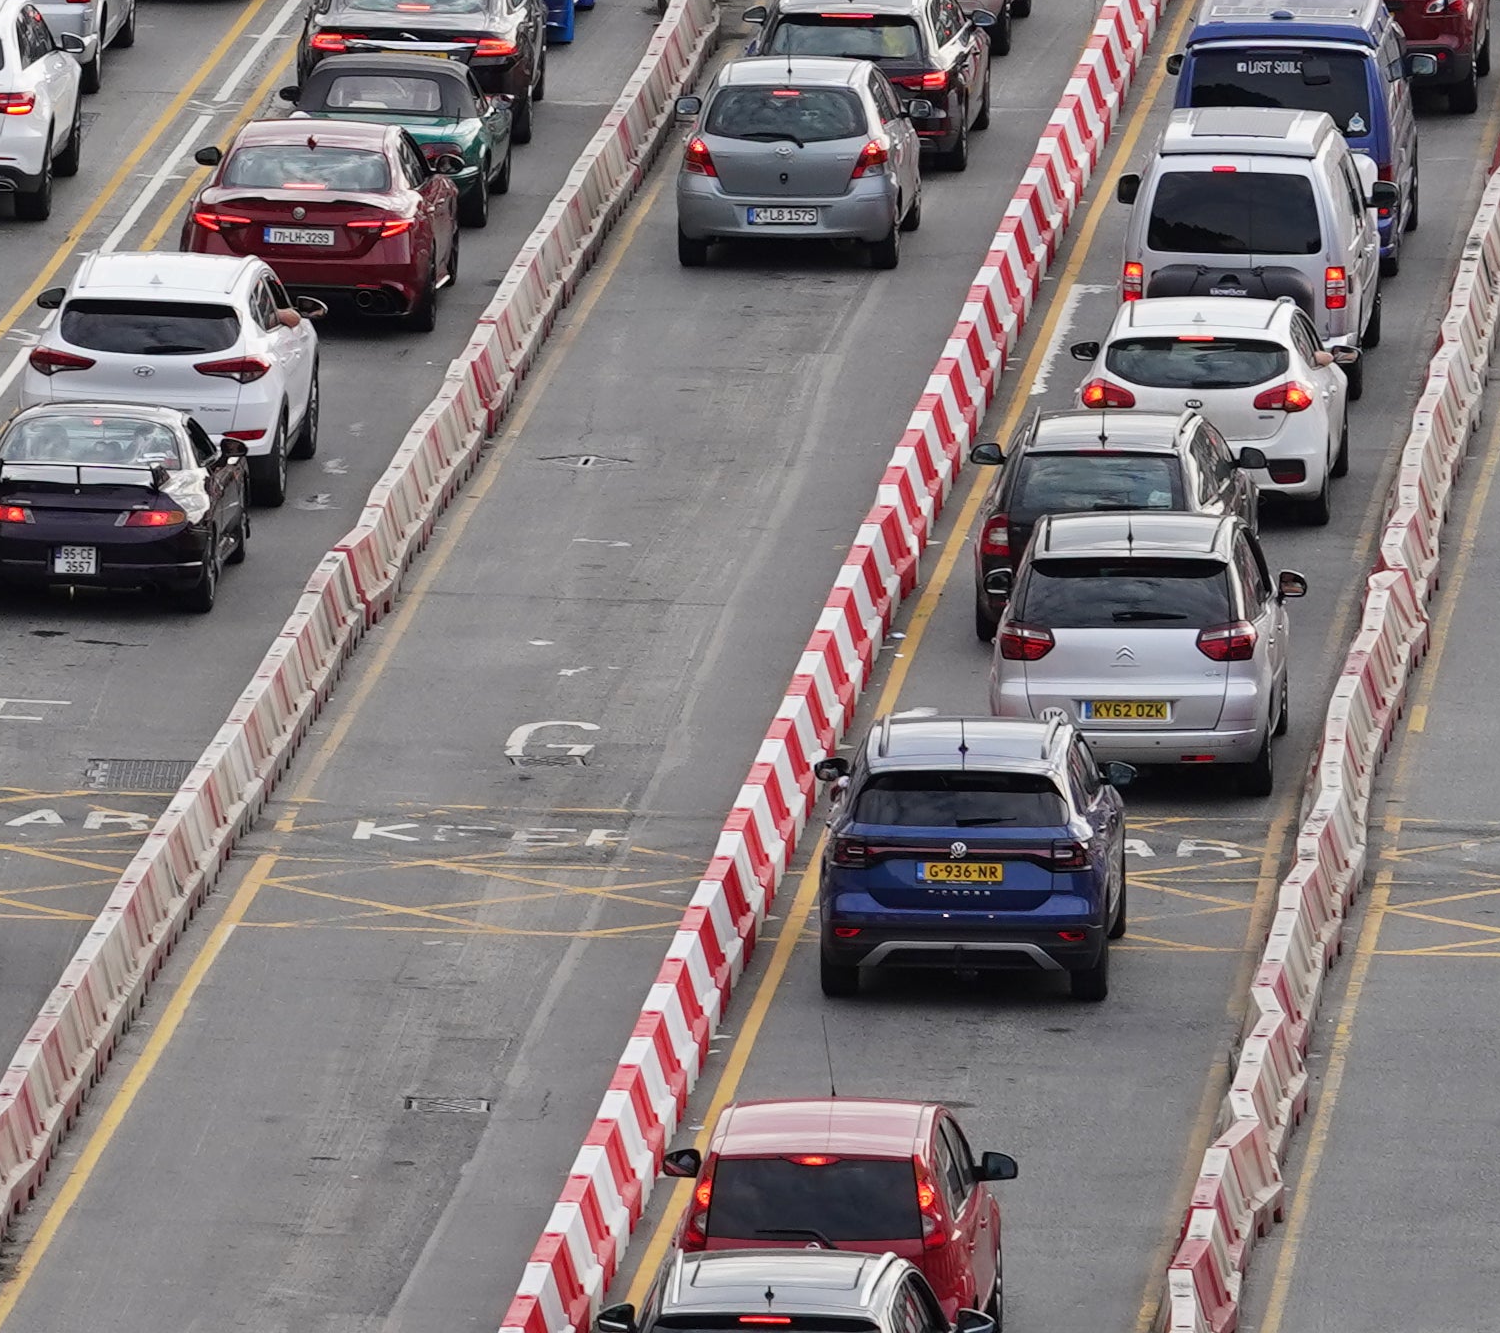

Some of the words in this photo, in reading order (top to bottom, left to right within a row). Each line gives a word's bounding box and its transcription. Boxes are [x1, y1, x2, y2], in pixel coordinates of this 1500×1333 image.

[1248, 60, 1271, 74] LOST
[769, 207, 784, 221] LB
[787, 208, 816, 221] 1575
[62, 547, 94, 560] 95-CE
[64, 561, 91, 573] 3557
[1093, 703, 1133, 717] KY62
[1136, 703, 1165, 718] OZK
[503, 721, 602, 757] G
[928, 862, 999, 879] G-936-NR
